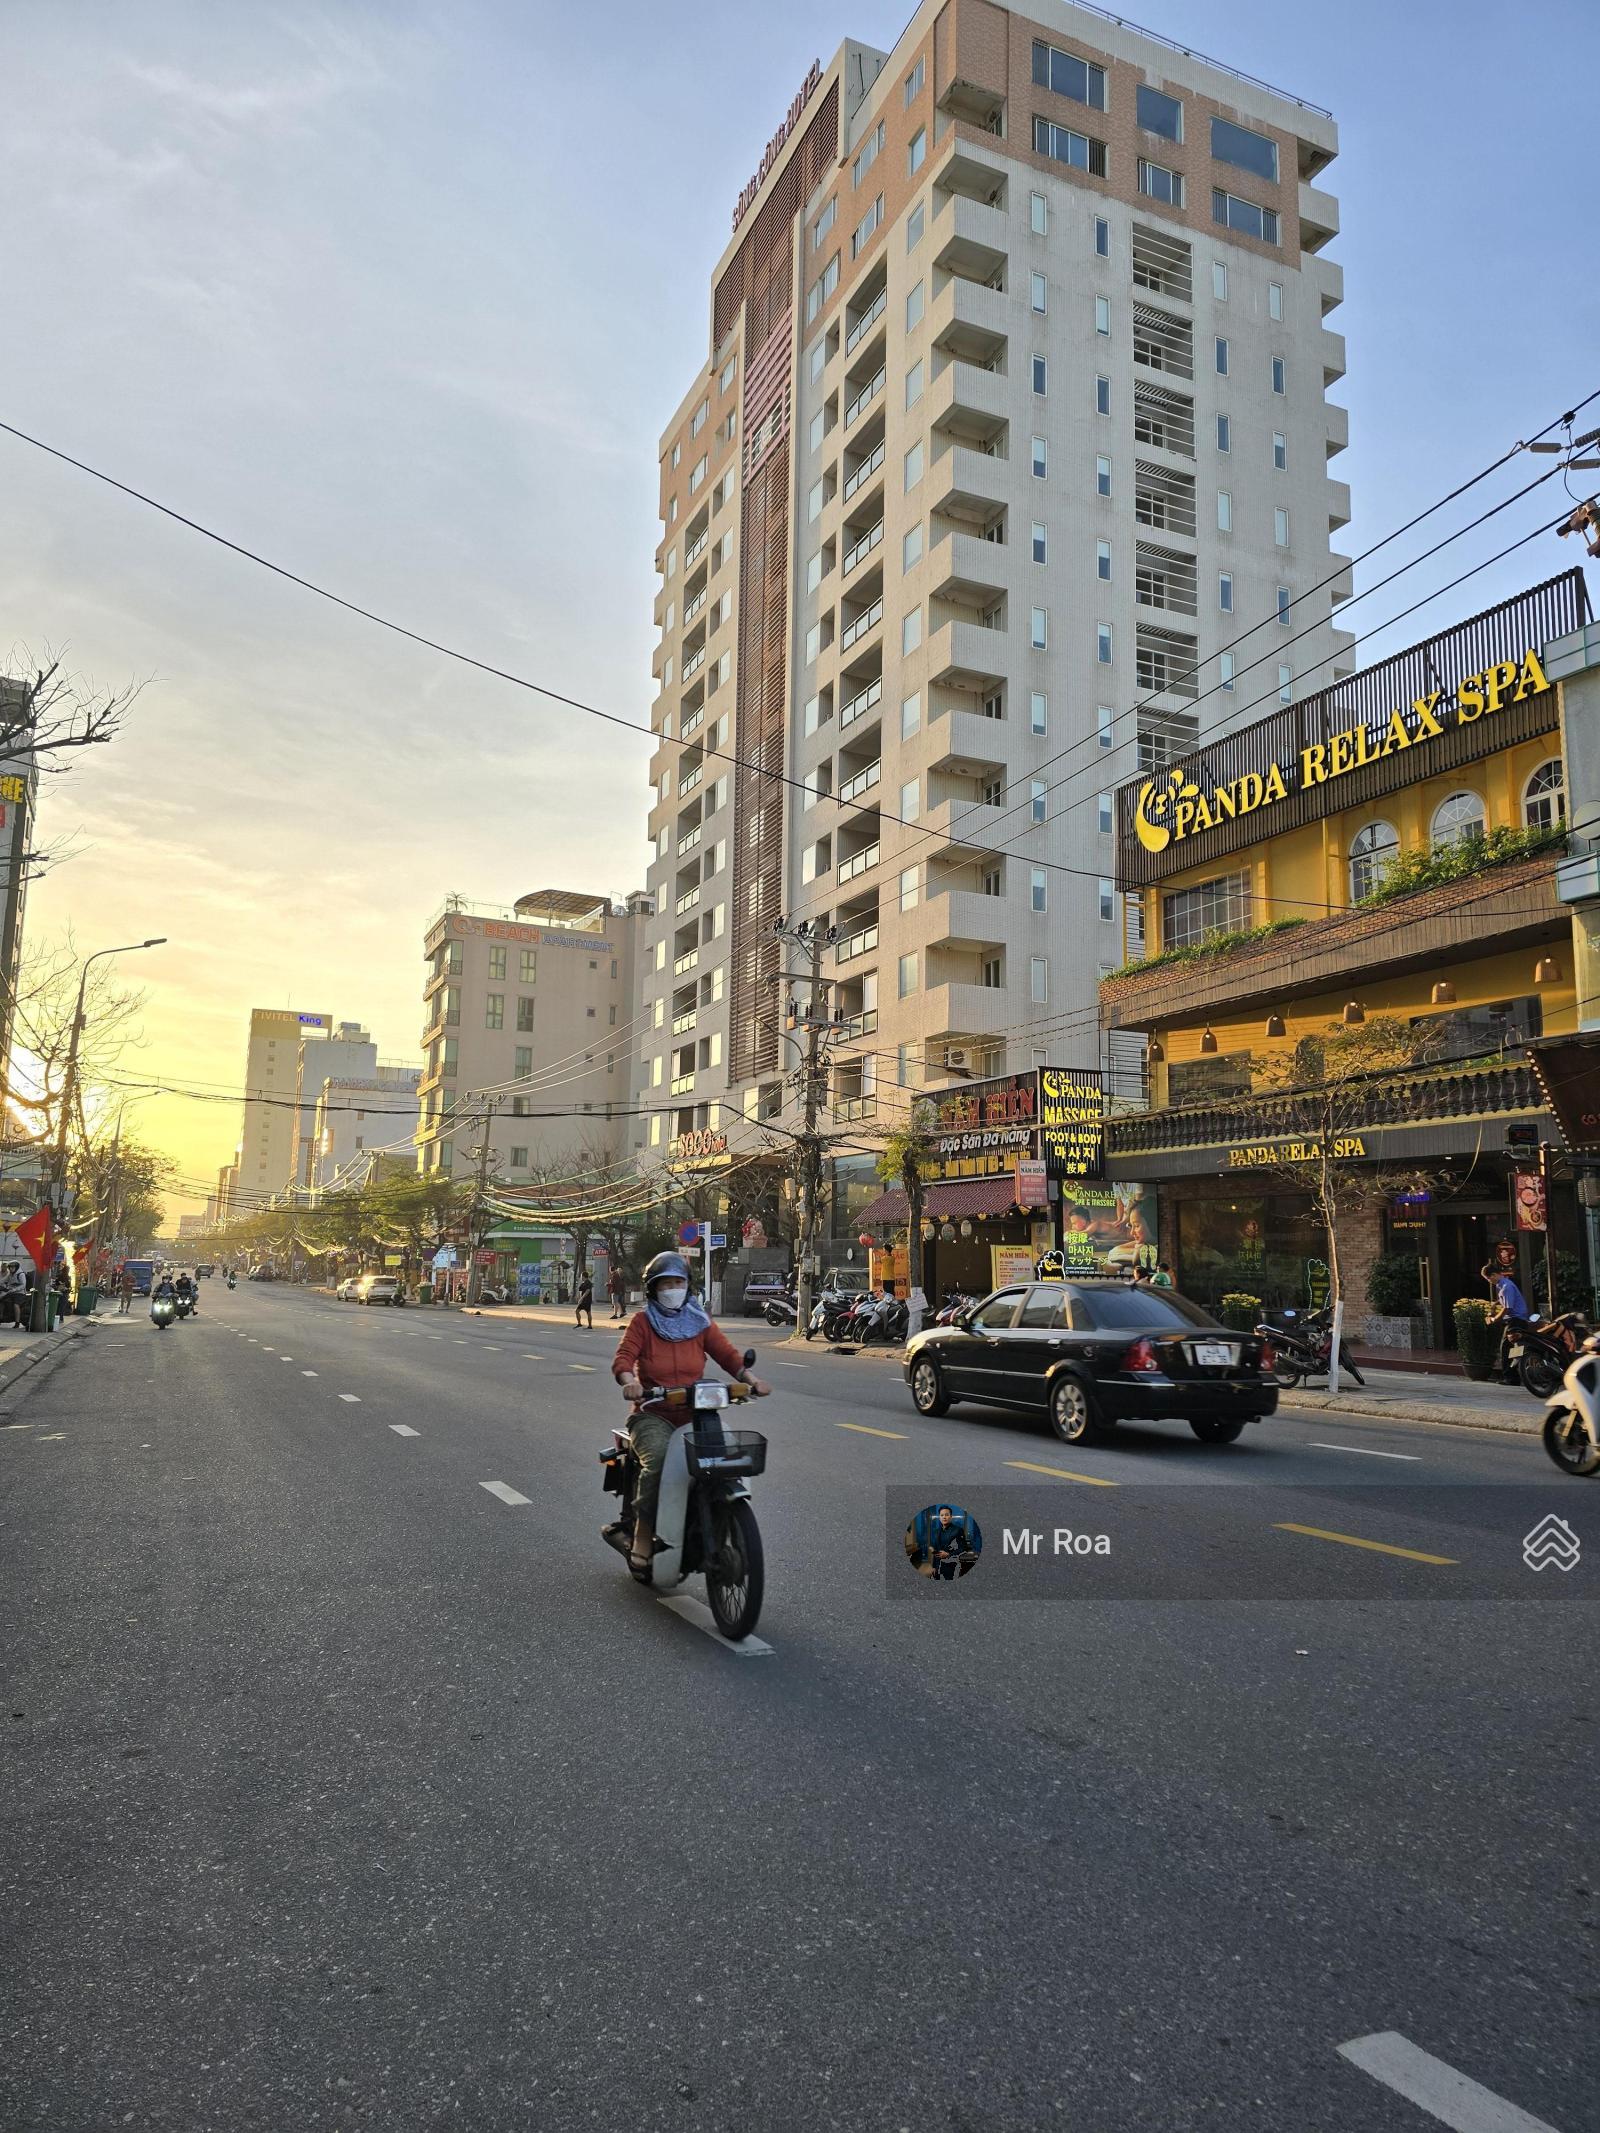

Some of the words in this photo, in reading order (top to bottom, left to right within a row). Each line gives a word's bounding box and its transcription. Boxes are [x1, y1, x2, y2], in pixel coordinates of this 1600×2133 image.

[1174, 762, 1288, 842] PANDA
[1300, 691, 1443, 790] RELAX
[1457, 648, 1551, 726] SPA
[484, 921, 541, 945] BEACH
[254, 1011, 296, 1022] FIVITEL
[299, 1014, 322, 1026] King
[1061, 1085, 1102, 1100] PANDA
[1044, 1106, 1102, 1128] MASSAGE
[1045, 1131, 1069, 1142] FOOT
[1070, 1132, 1077, 1143] &
[1078, 1133, 1102, 1144] BODY
[1054, 1146, 1095, 1160] 마사지
[1229, 1146, 1278, 1167] PANDA
[1334, 1137, 1366, 1158] SPA
[1066, 1162, 1087, 1174] 按摩
[1074, 1188, 1104, 1199] PANDA
[1068, 1245, 1094, 1256] 마사지
[1068, 1256, 1109, 1266] マッサージ
